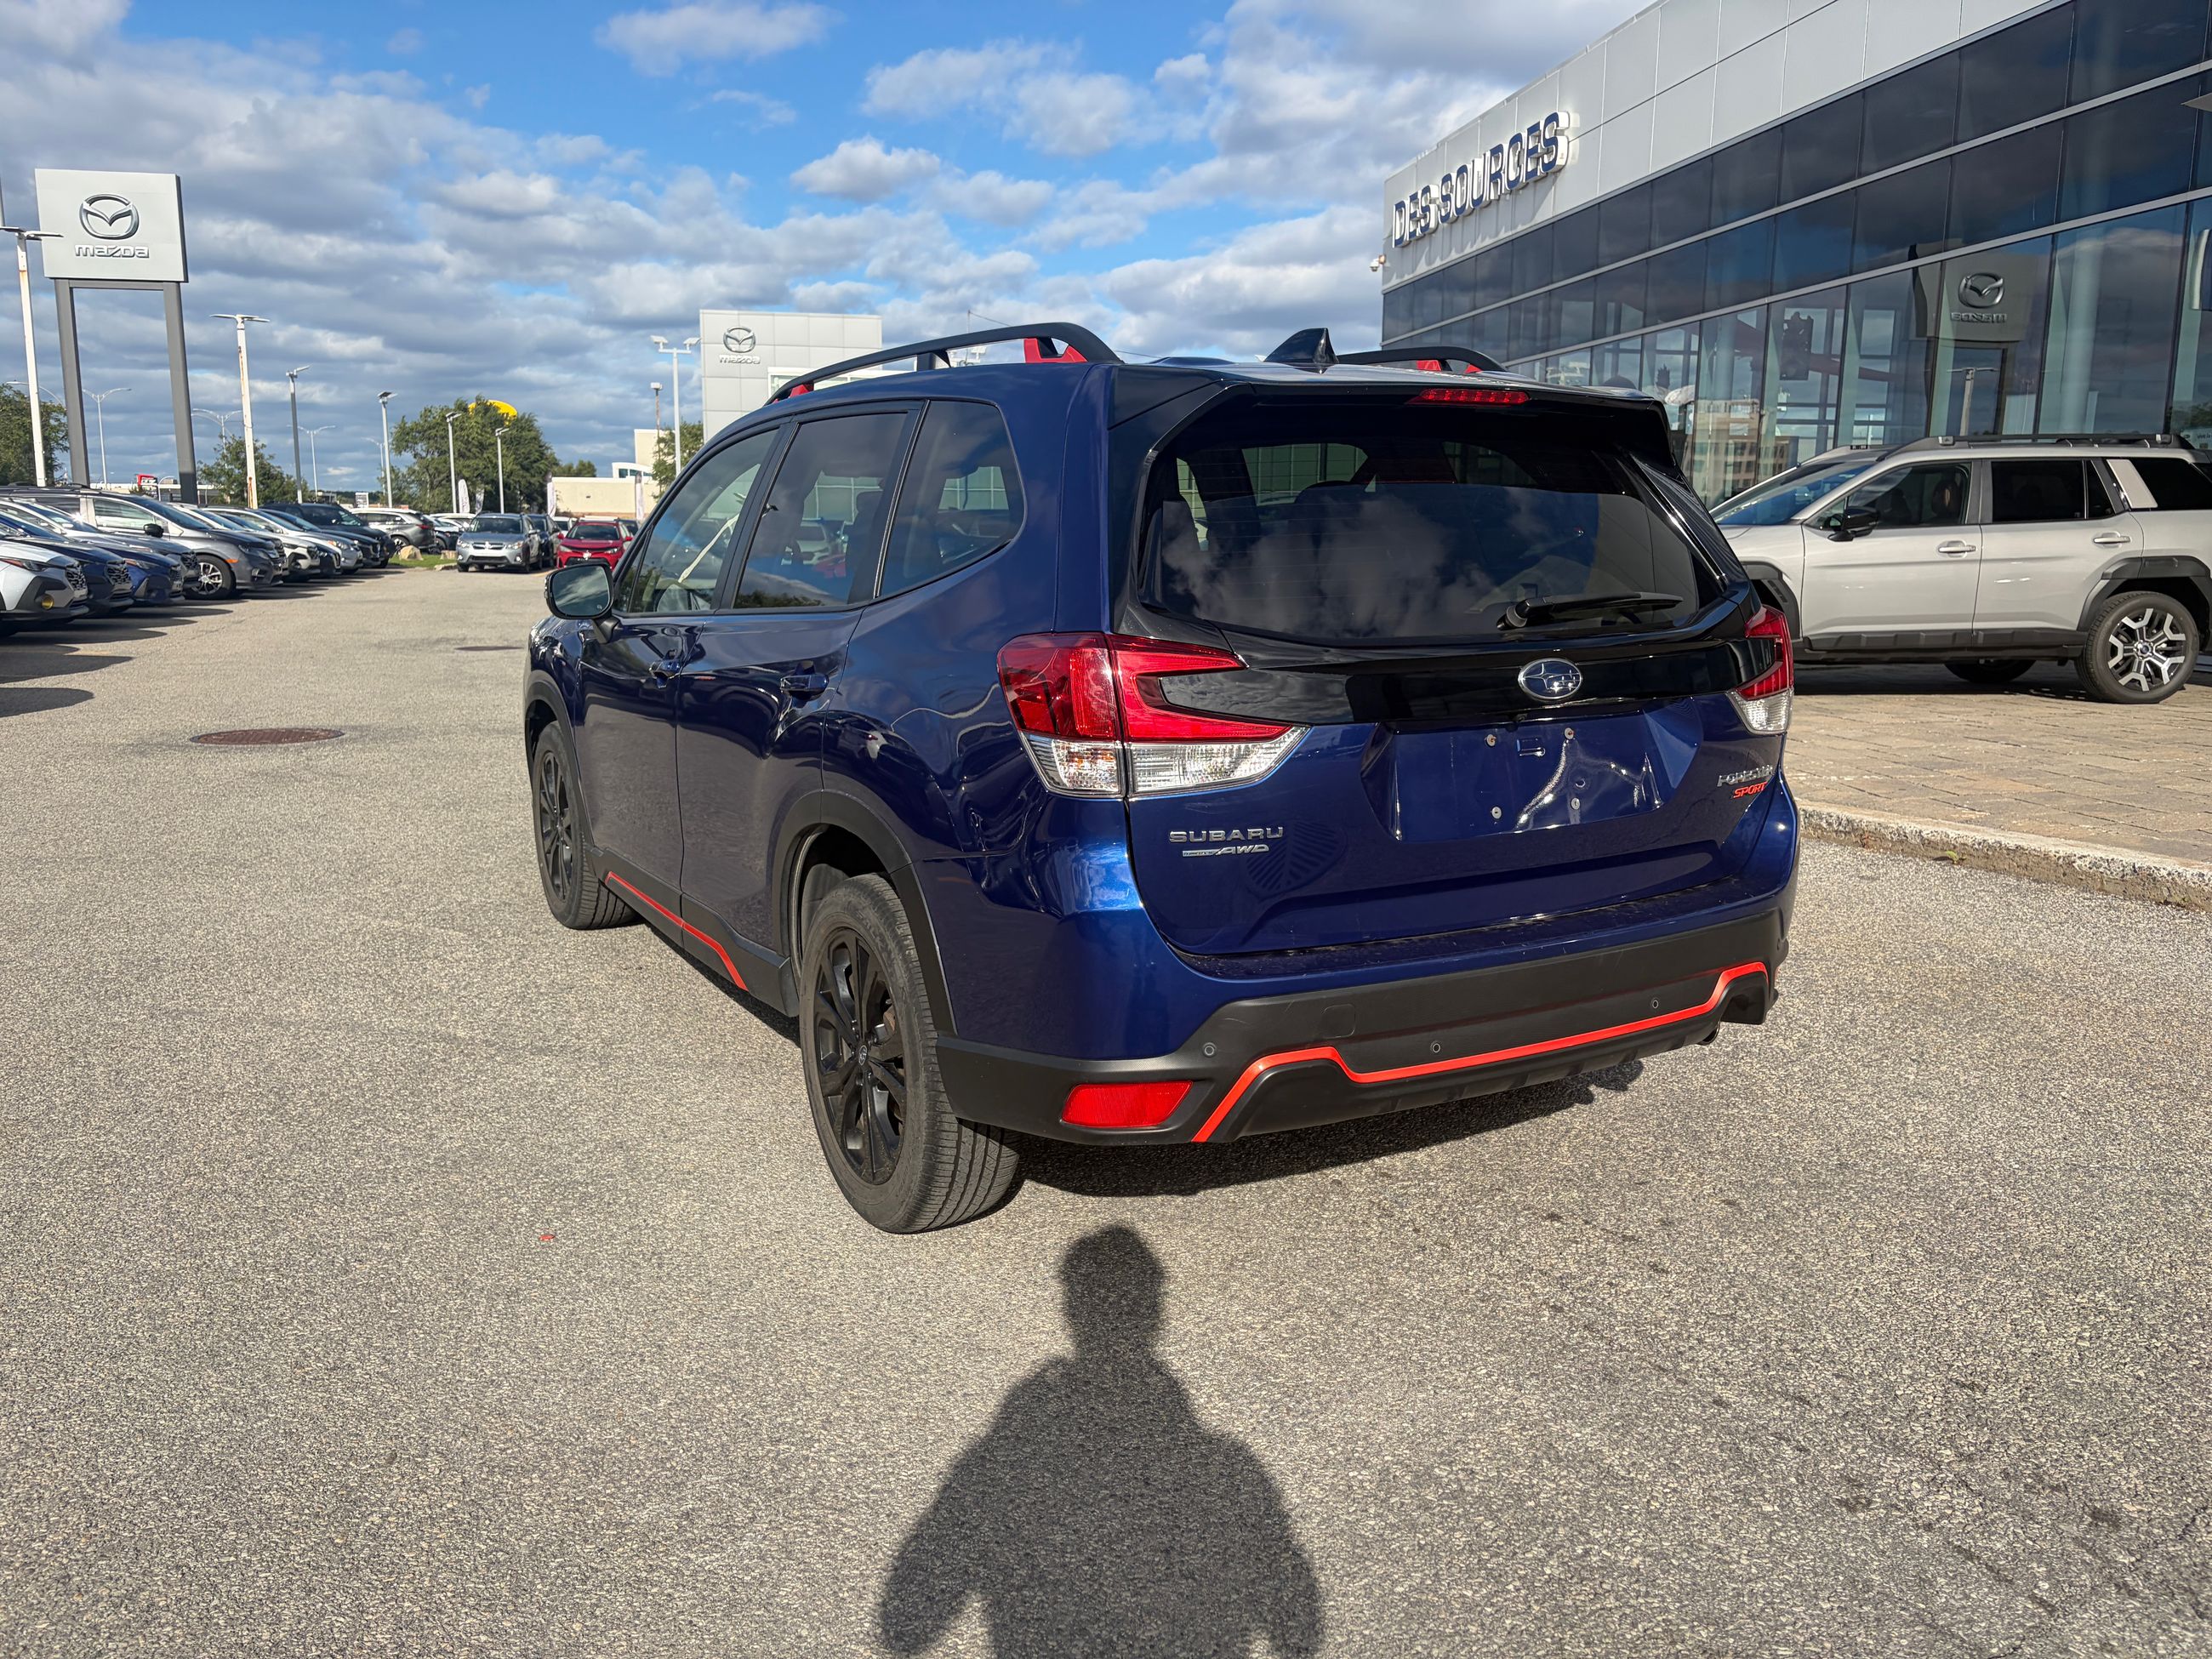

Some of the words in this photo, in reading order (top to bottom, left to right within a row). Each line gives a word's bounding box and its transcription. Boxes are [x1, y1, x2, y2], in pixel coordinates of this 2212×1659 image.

[1392, 185, 1438, 248] DES
[1438, 111, 1570, 225] SOURCES
[1733, 781, 1768, 799] SPORT
[1169, 826, 1284, 843] SUBARU
[1215, 844, 1270, 856] AWD
